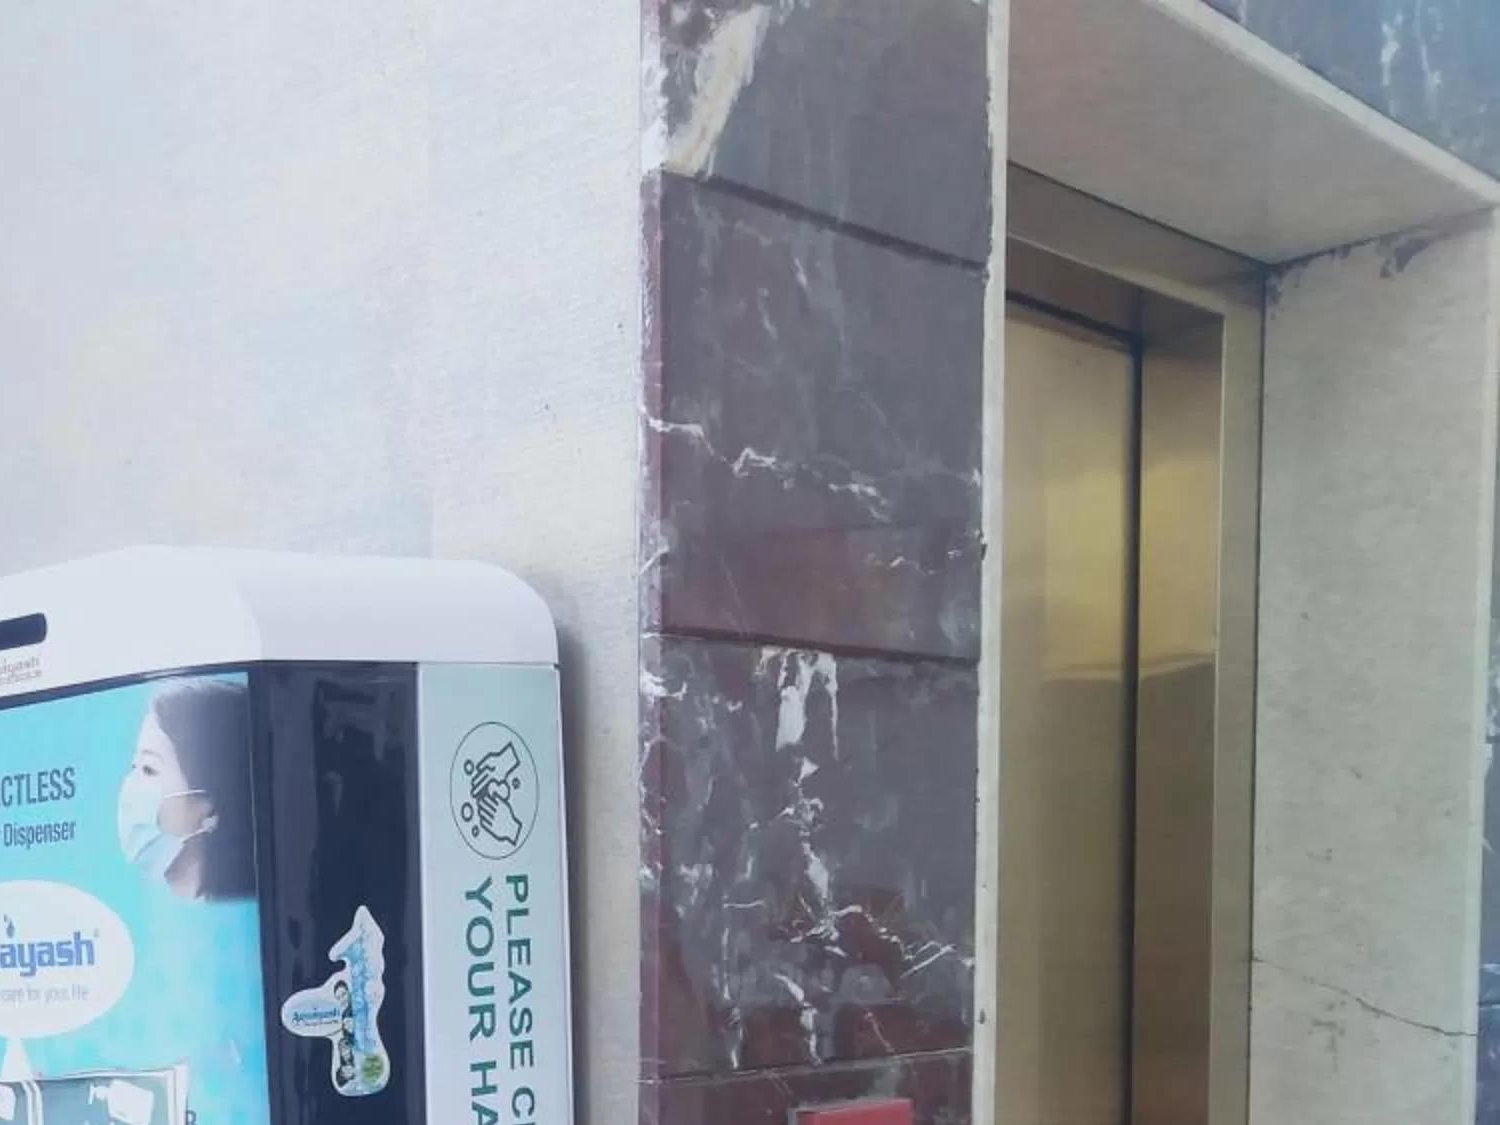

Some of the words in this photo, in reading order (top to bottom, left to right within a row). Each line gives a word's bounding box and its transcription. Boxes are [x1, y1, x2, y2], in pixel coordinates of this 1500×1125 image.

[3, 820, 76, 850] Dispenser
[465, 876, 497, 1041] YOUR
[505, 873, 535, 1070] PLEASE
